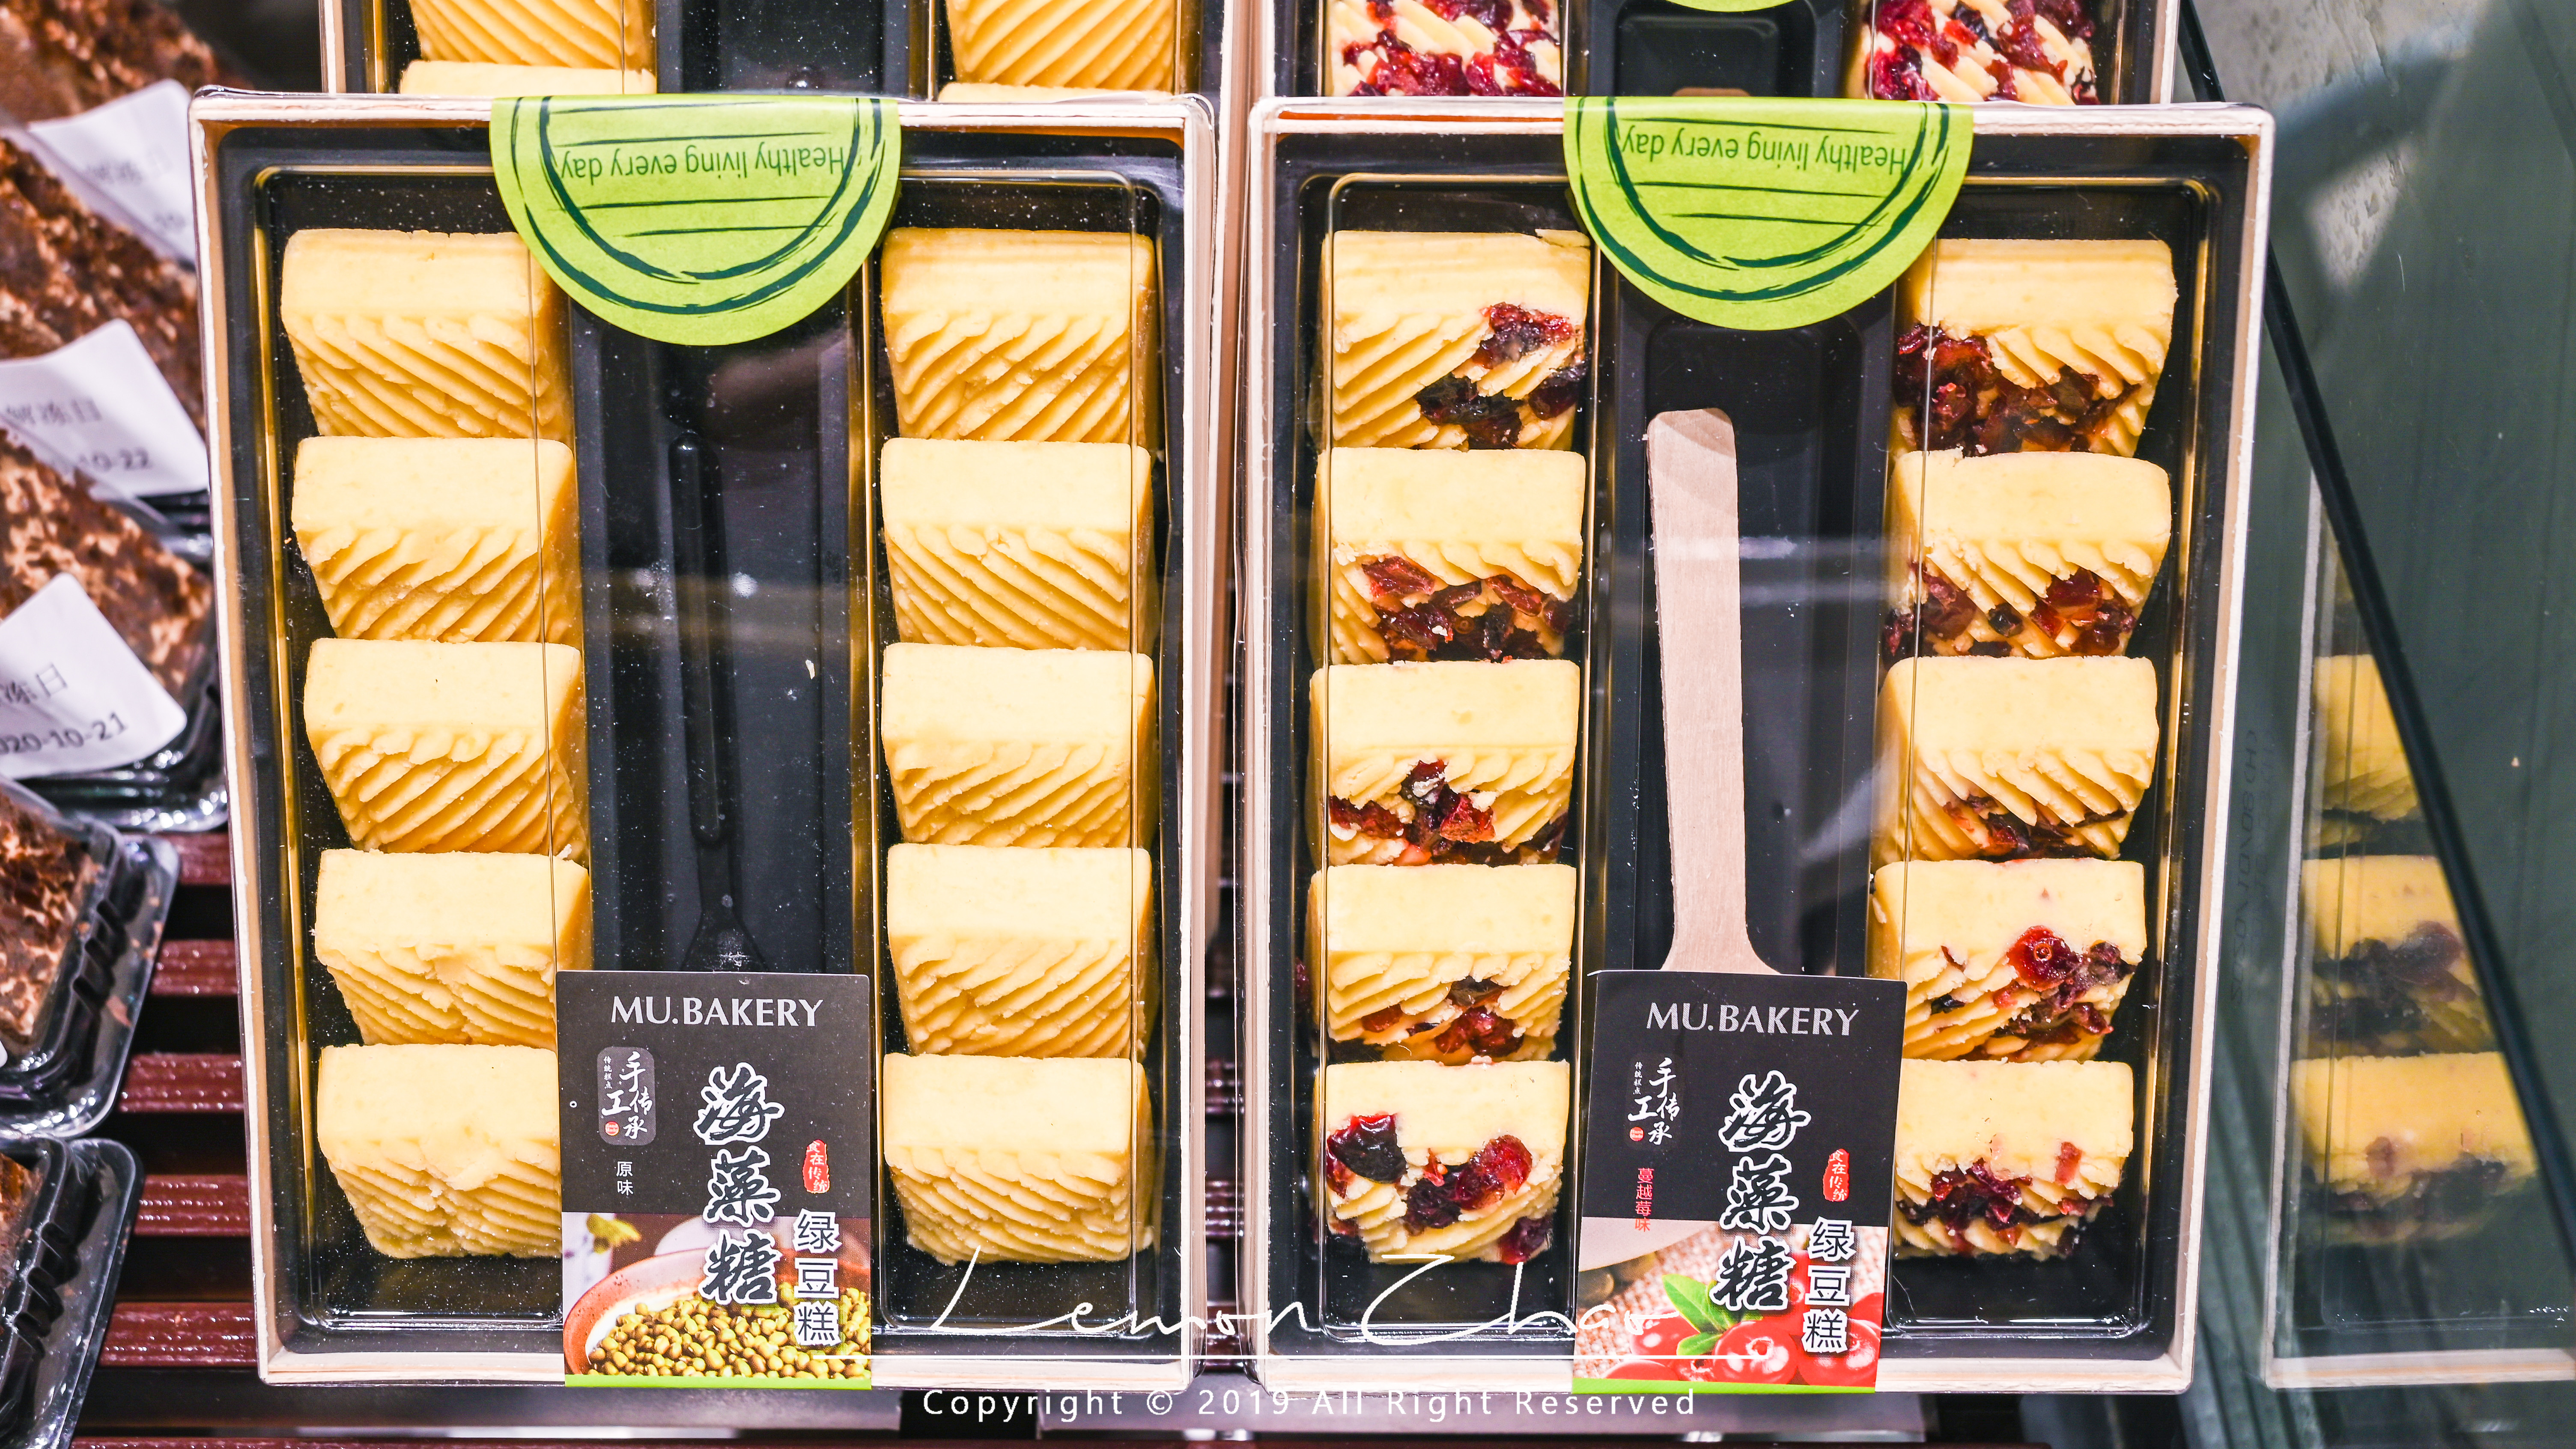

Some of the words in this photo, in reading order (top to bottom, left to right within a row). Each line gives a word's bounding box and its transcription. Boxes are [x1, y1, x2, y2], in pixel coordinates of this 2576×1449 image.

[753, 141, 844, 176] Healthy
[1622, 125, 1665, 162] day
[1671, 127, 1738, 159] every
[1747, 130, 1808, 170] living
[1816, 135, 1907, 175] Healthy
[561, 150, 603, 186] day
[611, 147, 677, 177] every
[685, 145, 747, 179] living
[611, 996, 824, 1027] MU.BAKERY
[1646, 1002, 1859, 1036] MU.BAKERY
[616, 1161, 634, 1196] 原味
[1634, 1168, 1655, 1232] 蔓越莓味
[793, 1208, 842, 1347] 绿豆糕
[1801, 1216, 1856, 1353] 绿豆糕
